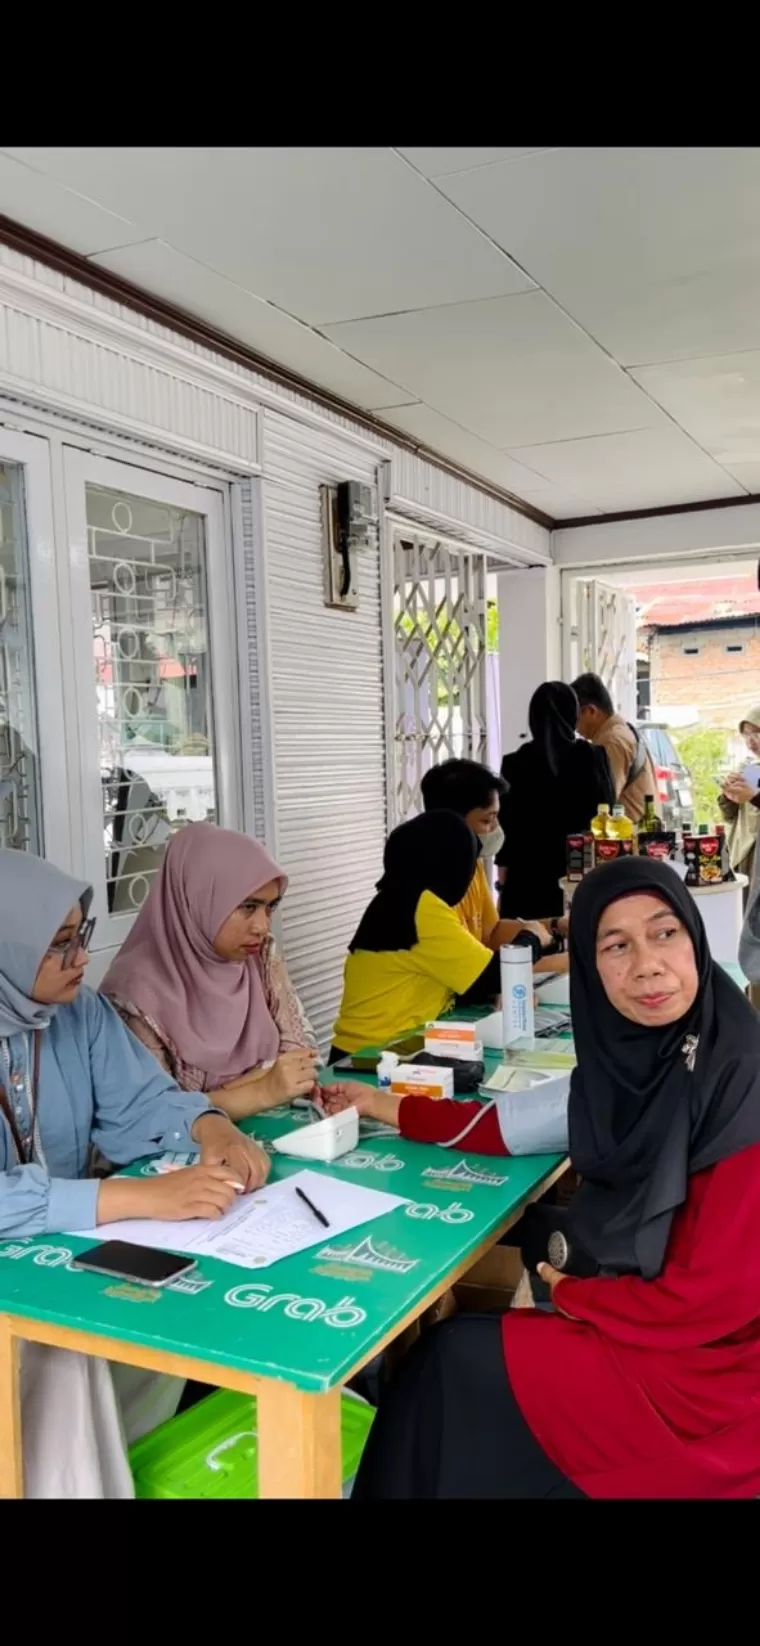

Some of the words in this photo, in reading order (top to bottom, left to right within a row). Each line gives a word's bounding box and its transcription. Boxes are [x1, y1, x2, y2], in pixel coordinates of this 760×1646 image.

[345, 1153, 406, 1171] ab
[404, 1202, 475, 1224] ab
[0, 1237, 84, 1272] Gra
[224, 1283, 367, 1328] Grab
